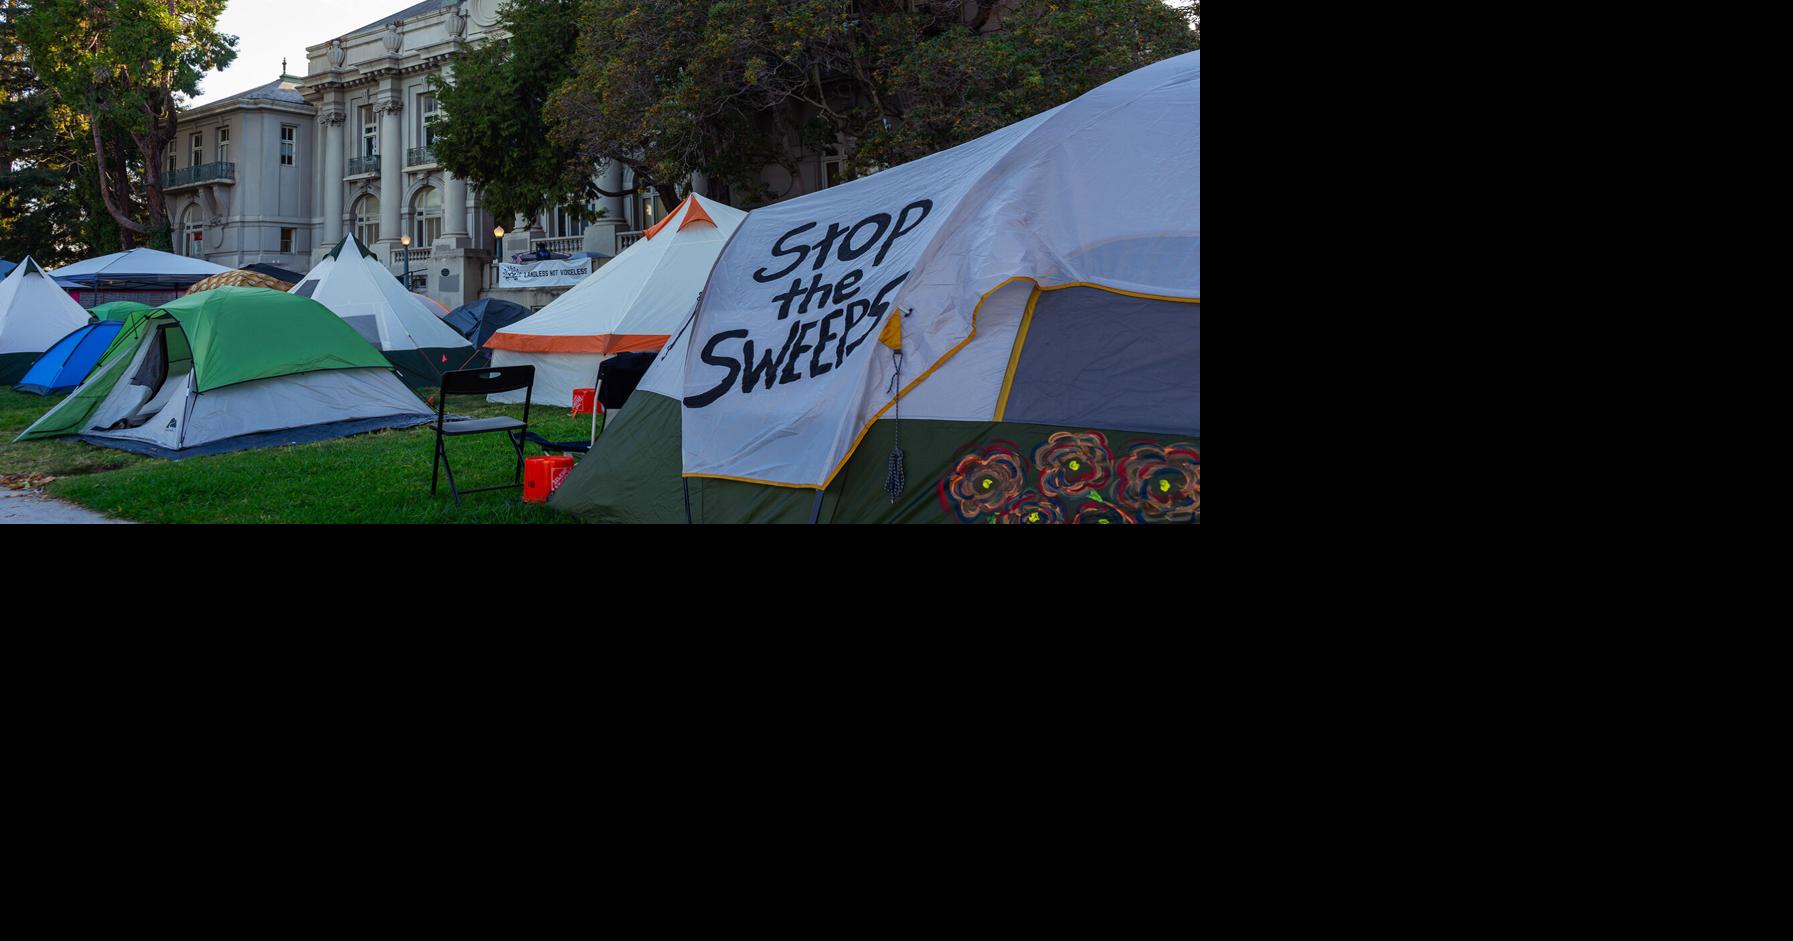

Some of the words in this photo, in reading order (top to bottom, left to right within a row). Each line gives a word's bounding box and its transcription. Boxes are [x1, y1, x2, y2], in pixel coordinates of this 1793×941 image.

[523, 269, 549, 278] LANDLESS
[560, 267, 588, 276] VOICELESS
[771, 269, 863, 320] the
[683, 270, 911, 408] SWEEPS
